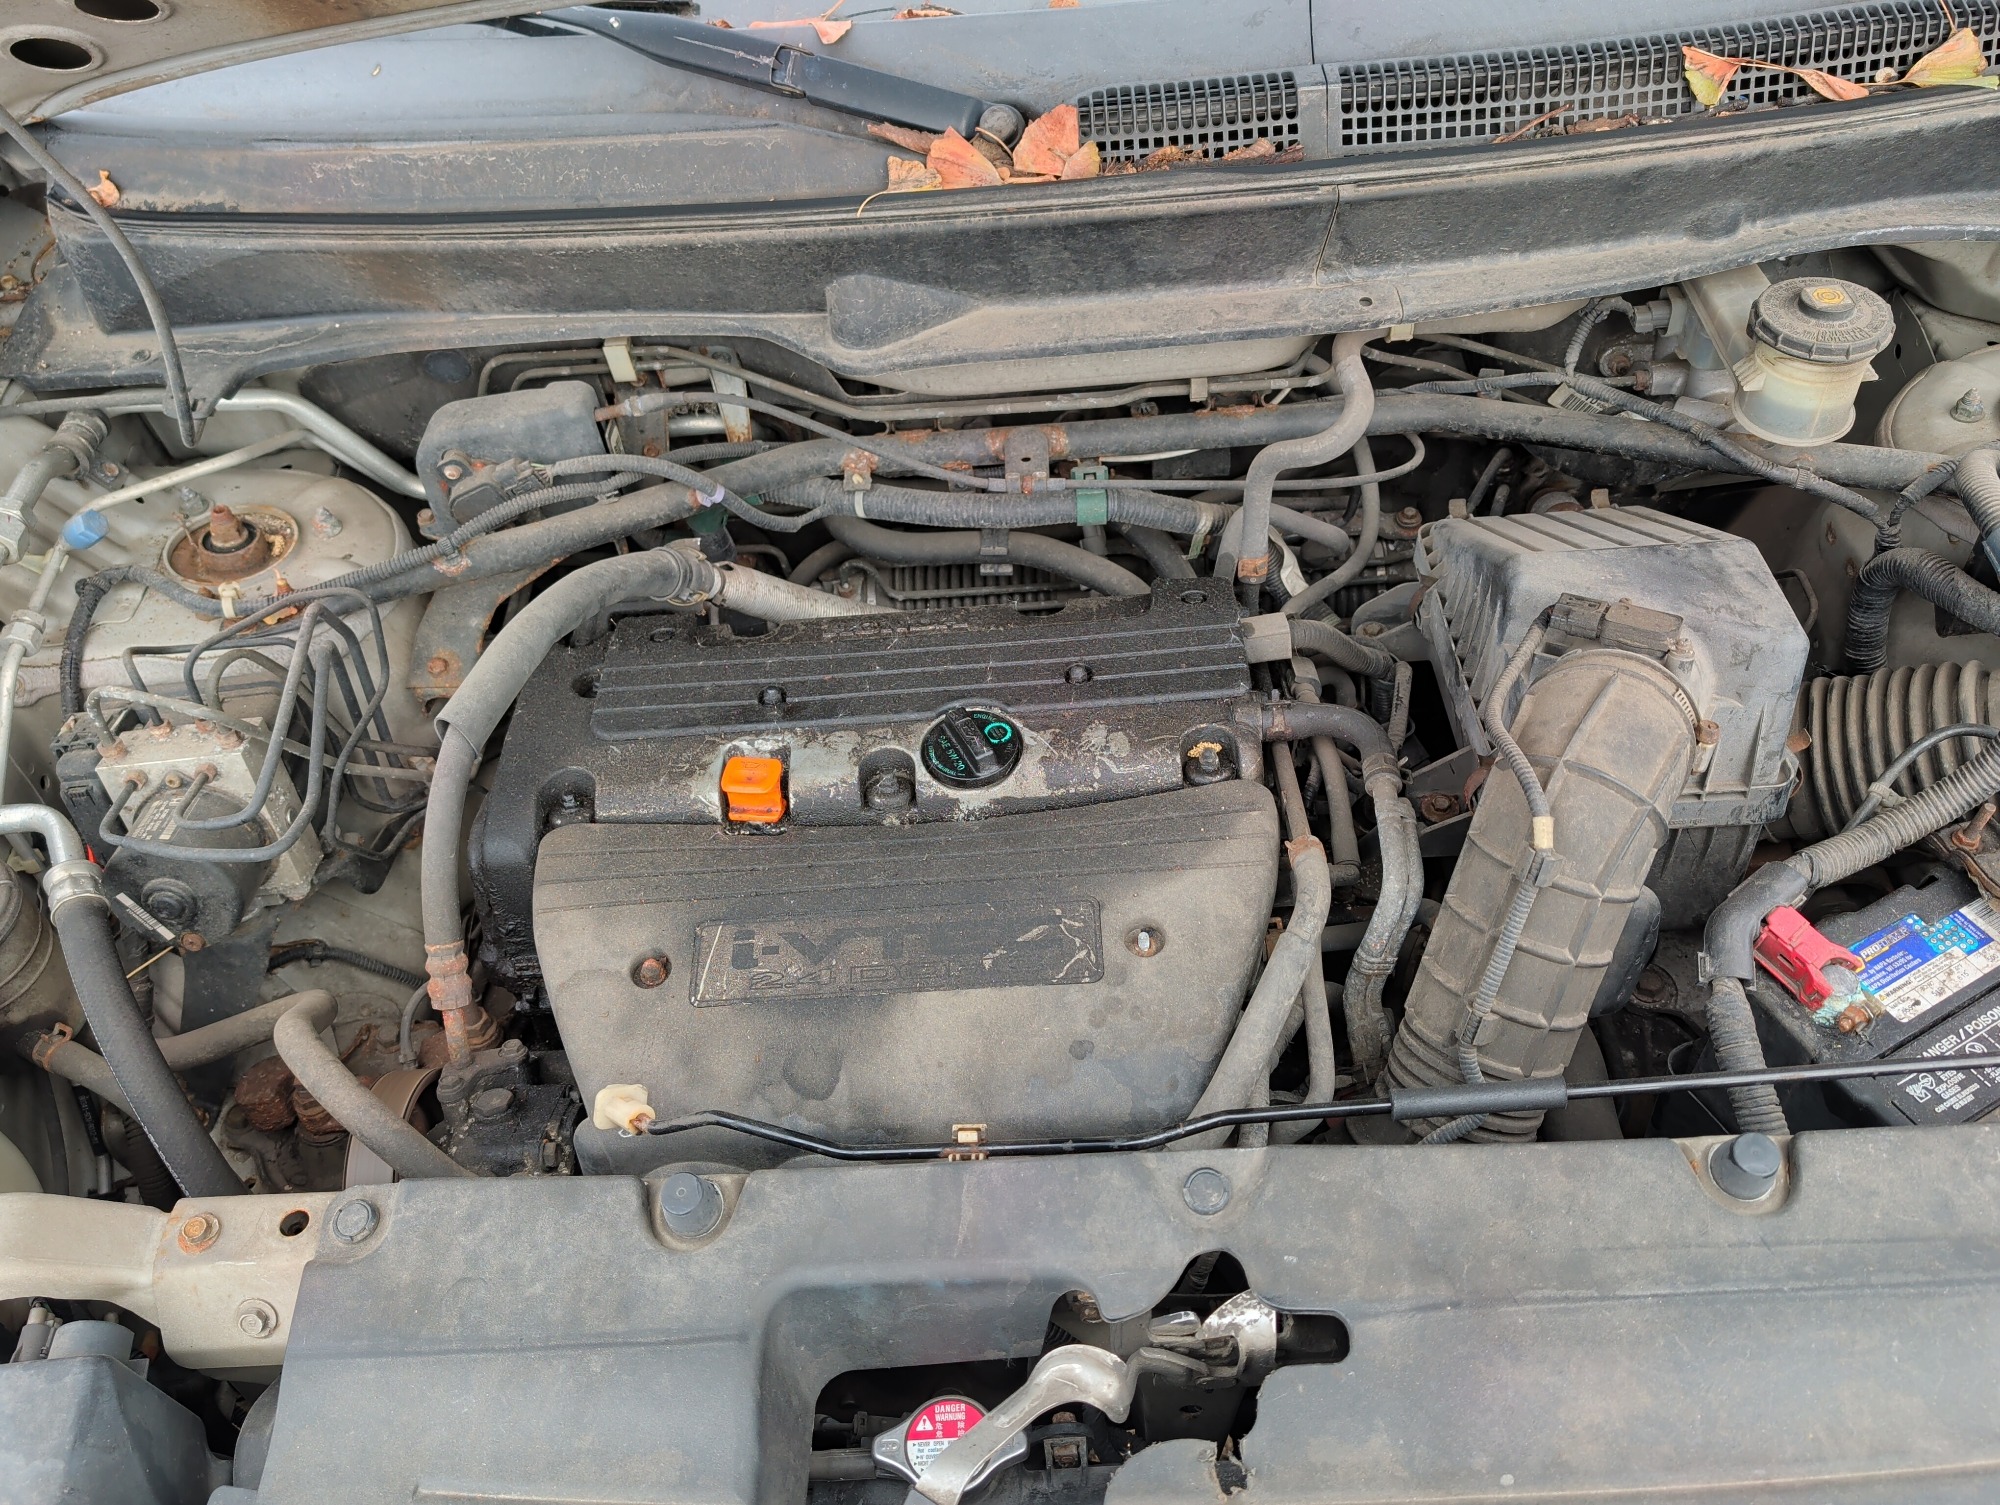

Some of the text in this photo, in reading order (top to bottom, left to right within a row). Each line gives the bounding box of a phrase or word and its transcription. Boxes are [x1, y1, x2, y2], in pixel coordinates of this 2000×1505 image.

[973, 713, 997, 723] ENGINE
[939, 735, 950, 751] SAE
[1917, 1034, 1961, 1057] ANGER
[1940, 1070, 1957, 1081] EYES
[1934, 1072, 1966, 1095] EXPLOSIVE
[1941, 1084, 1961, 1100] GASES
[935, 1403, 966, 1413] DANGER
[935, 1412, 966, 1421] WARNUNG
